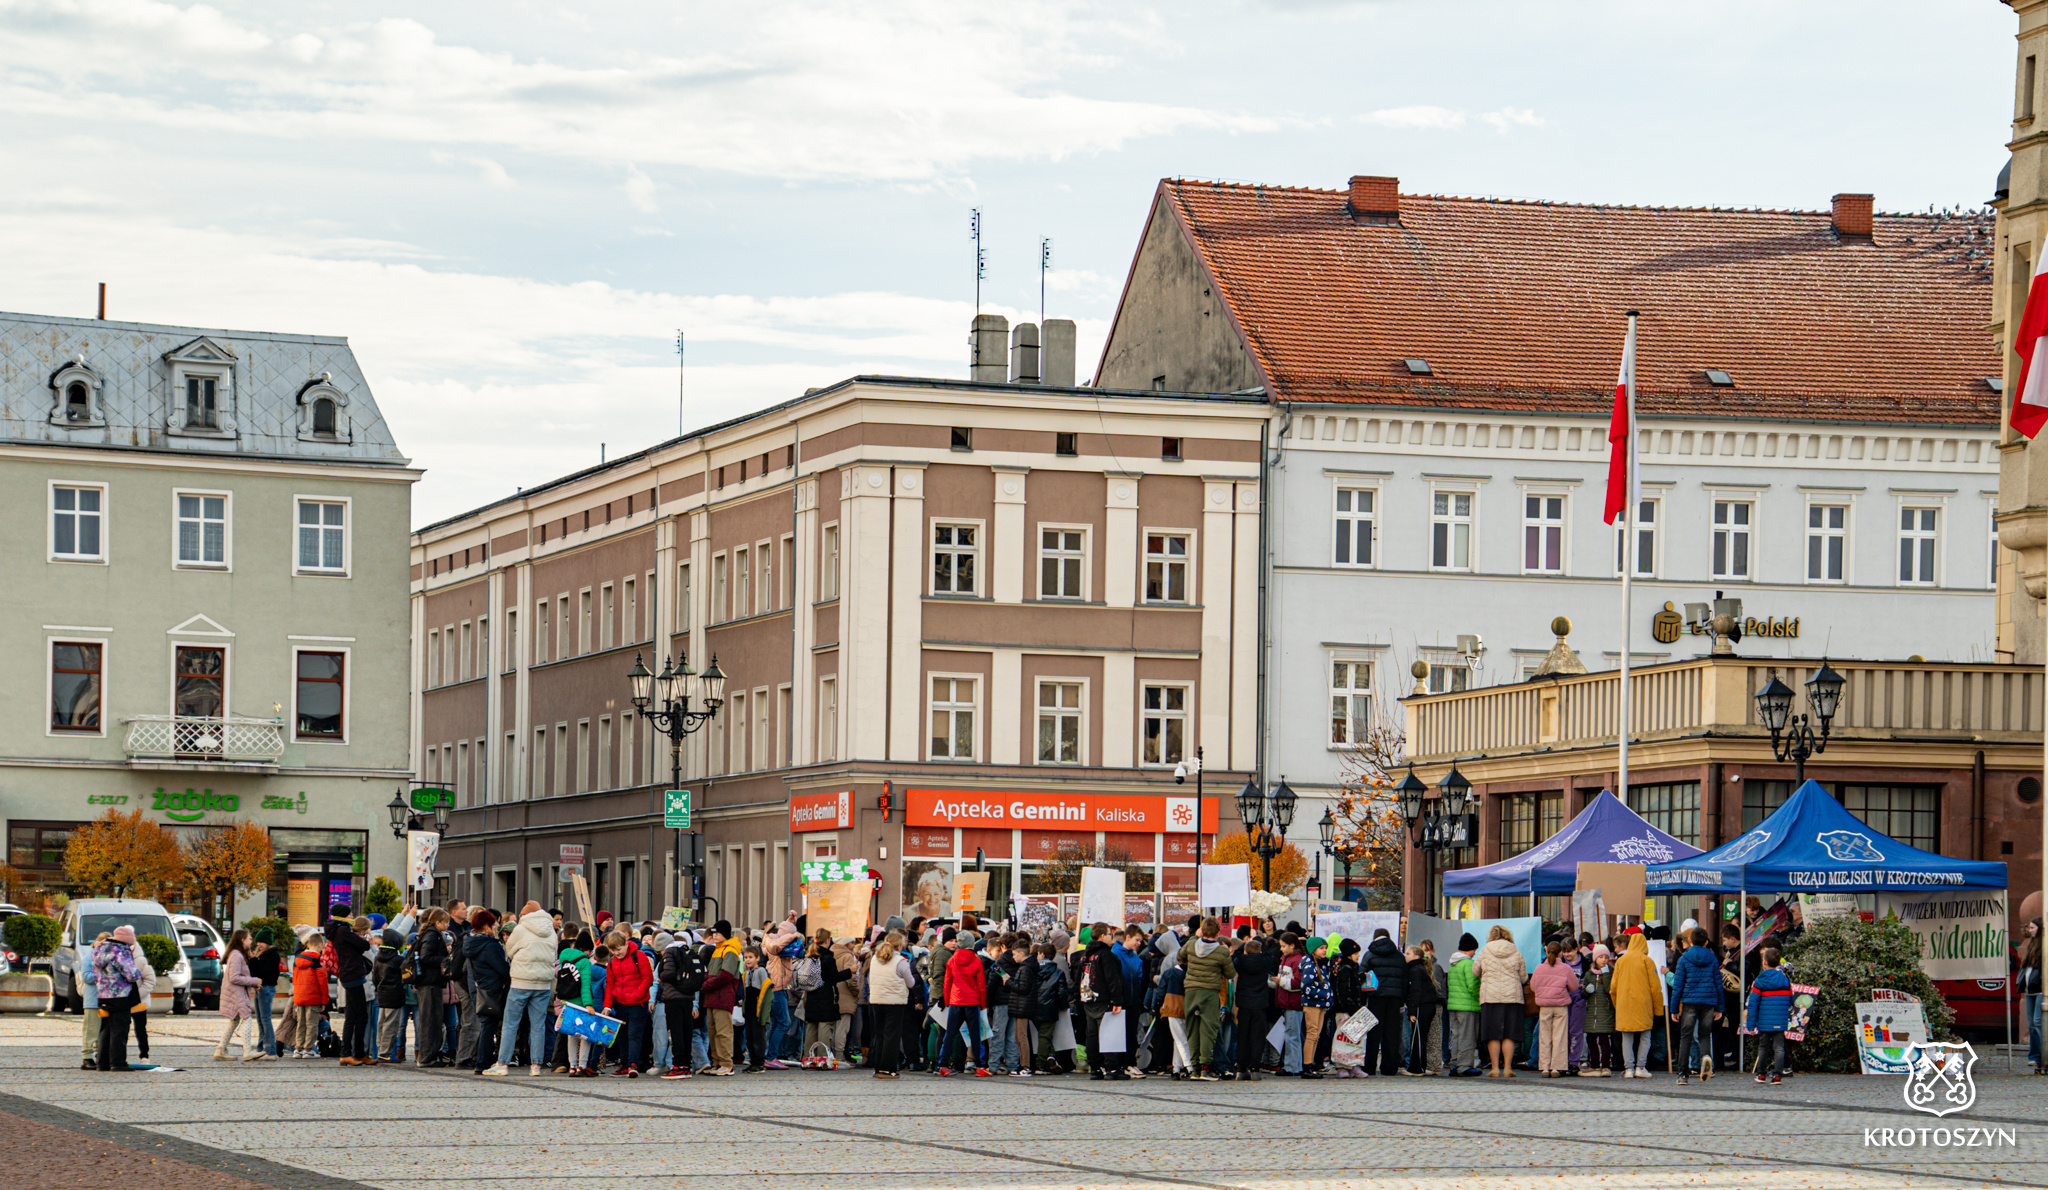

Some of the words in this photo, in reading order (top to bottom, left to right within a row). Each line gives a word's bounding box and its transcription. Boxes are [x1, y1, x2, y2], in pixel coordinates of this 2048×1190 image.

[1746, 616, 1800, 638] Polski
[87, 795, 128, 805] 6-23/7
[151, 787, 239, 811] żabka
[261, 796, 294, 809] café
[792, 804, 813, 827] Apteka
[813, 800, 837, 820] Gemini
[932, 799, 1004, 822] Apteka
[1009, 801, 1086, 820] Gemini
[1096, 808, 1146, 822] Kaliska
[561, 846, 582, 854] PRASA
[1788, 871, 1826, 888] URZĄD
[1827, 870, 1872, 886] MIEJSKI
[1874, 870, 1886, 884] W
[1886, 870, 1966, 886] KROTOSZYNIE
[1791, 983, 1819, 995] MIECI
[1873, 990, 1892, 1001] NIE
[1892, 990, 1907, 1001] PAL
